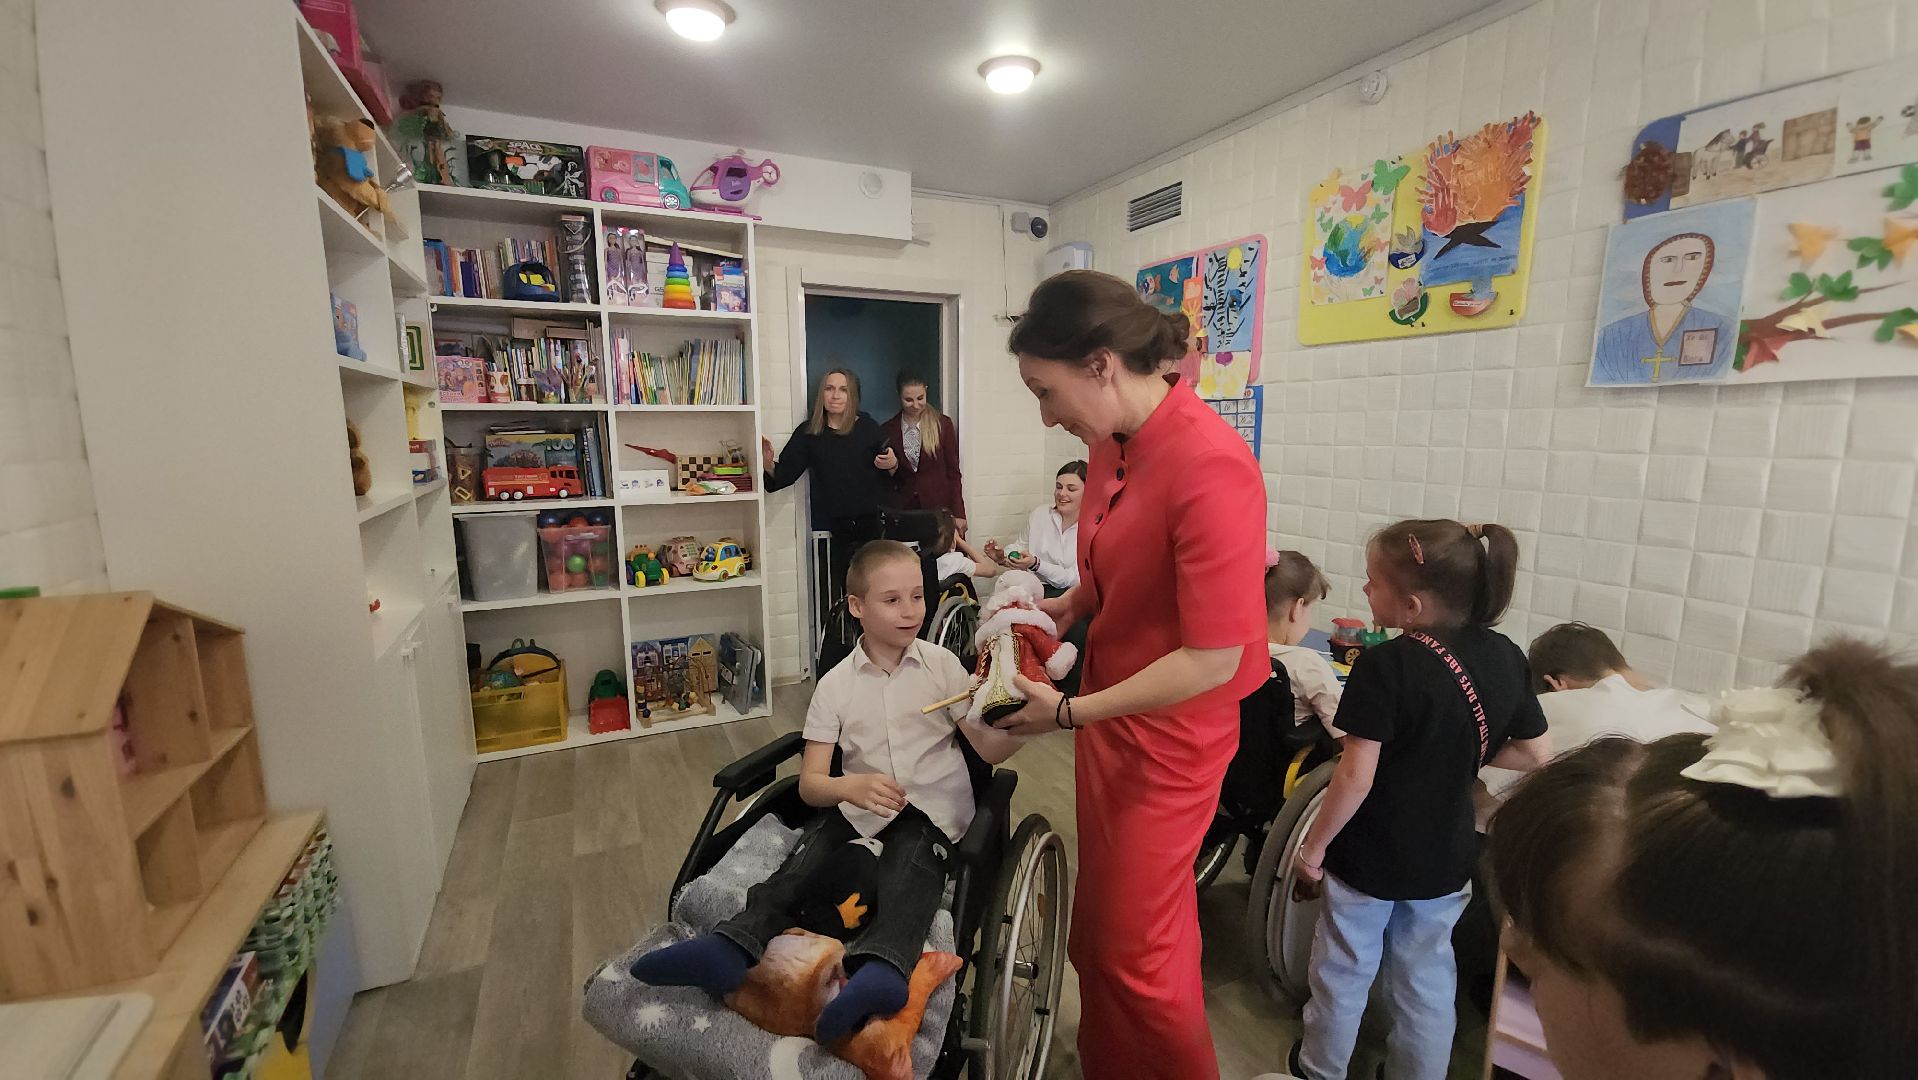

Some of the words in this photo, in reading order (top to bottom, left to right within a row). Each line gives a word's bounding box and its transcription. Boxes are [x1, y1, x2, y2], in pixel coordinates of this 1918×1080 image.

[1443, 653, 1463, 674] ARE
[1460, 675, 1478, 704] DAYS
[1473, 703, 1486, 721] ALL
